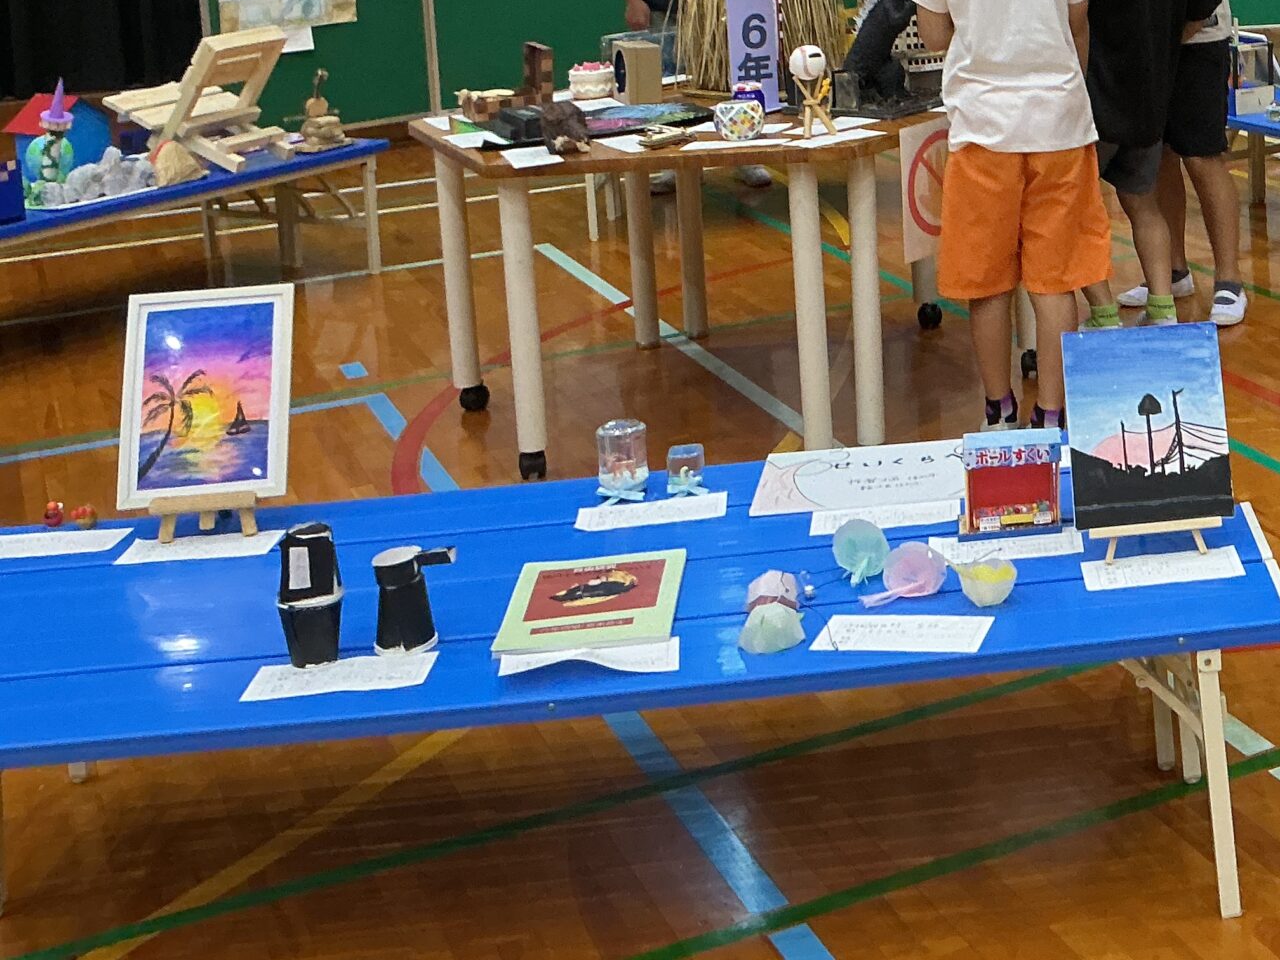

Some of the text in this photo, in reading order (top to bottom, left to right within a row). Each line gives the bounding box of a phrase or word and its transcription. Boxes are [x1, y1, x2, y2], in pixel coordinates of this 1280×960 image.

[737, 12, 773, 82] 6年
[976, 447, 1050, 465] ボールすくい
